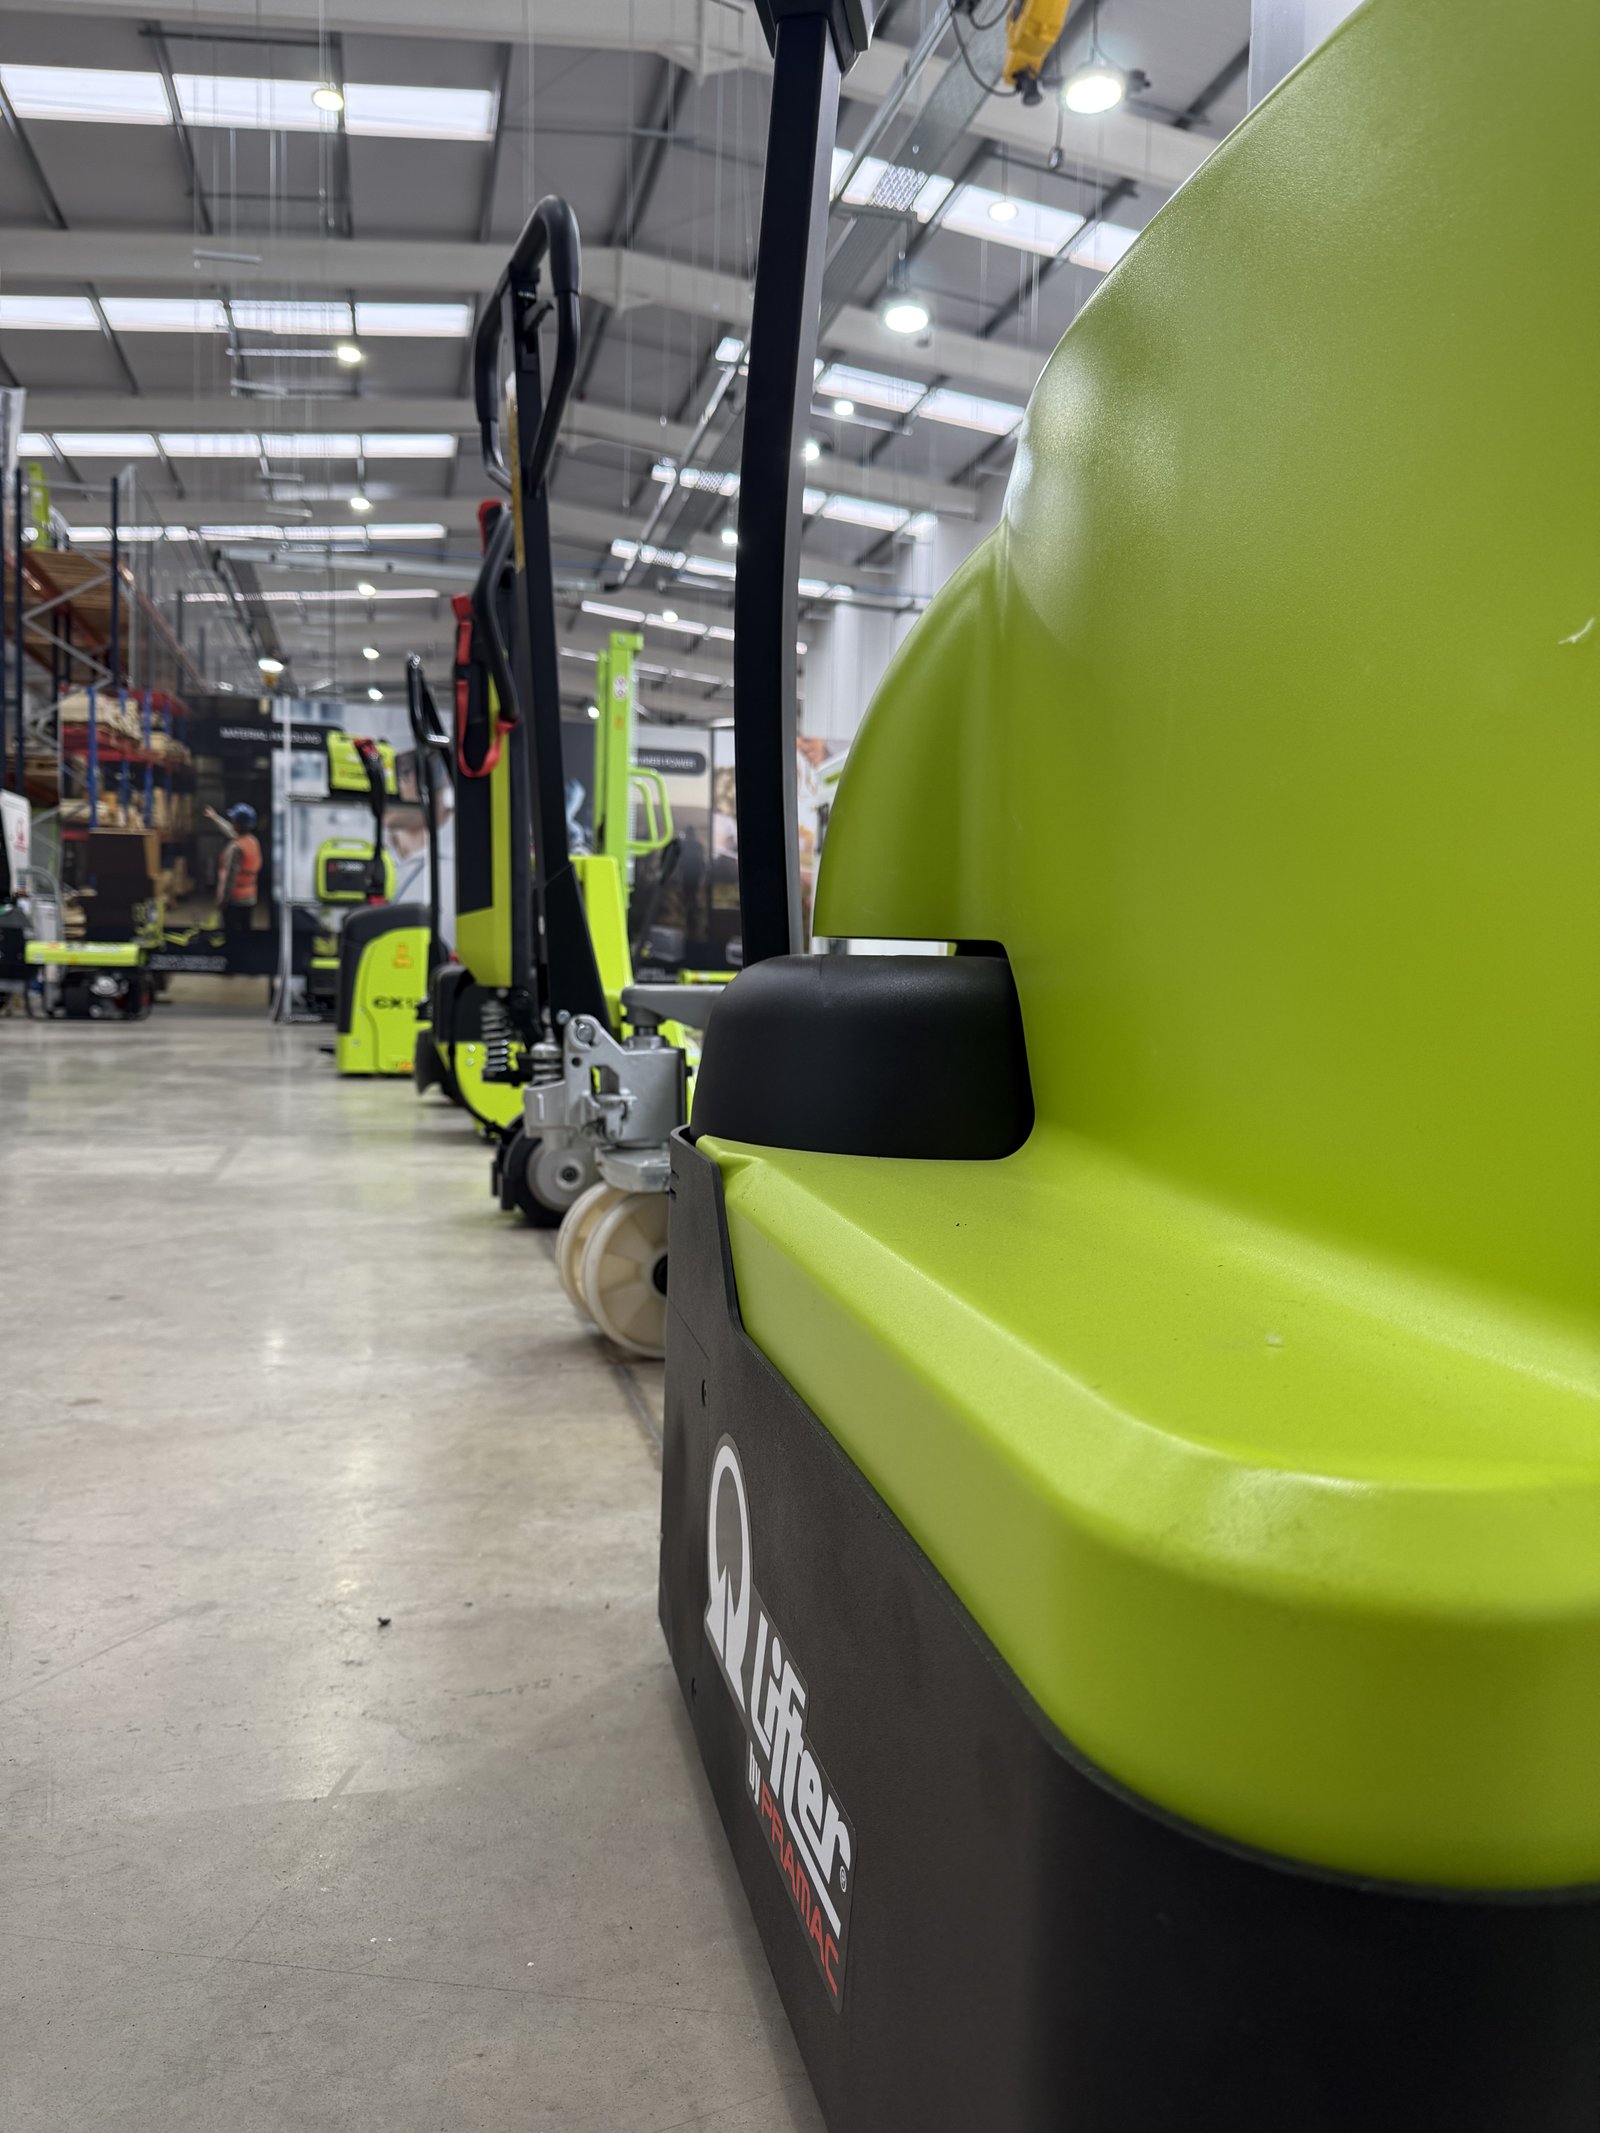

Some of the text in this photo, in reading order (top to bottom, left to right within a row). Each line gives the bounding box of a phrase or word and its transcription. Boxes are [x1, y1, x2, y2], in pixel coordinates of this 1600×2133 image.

[749, 1740, 840, 1998] by PRAMAC
[751, 1610, 851, 1940] Lifter
